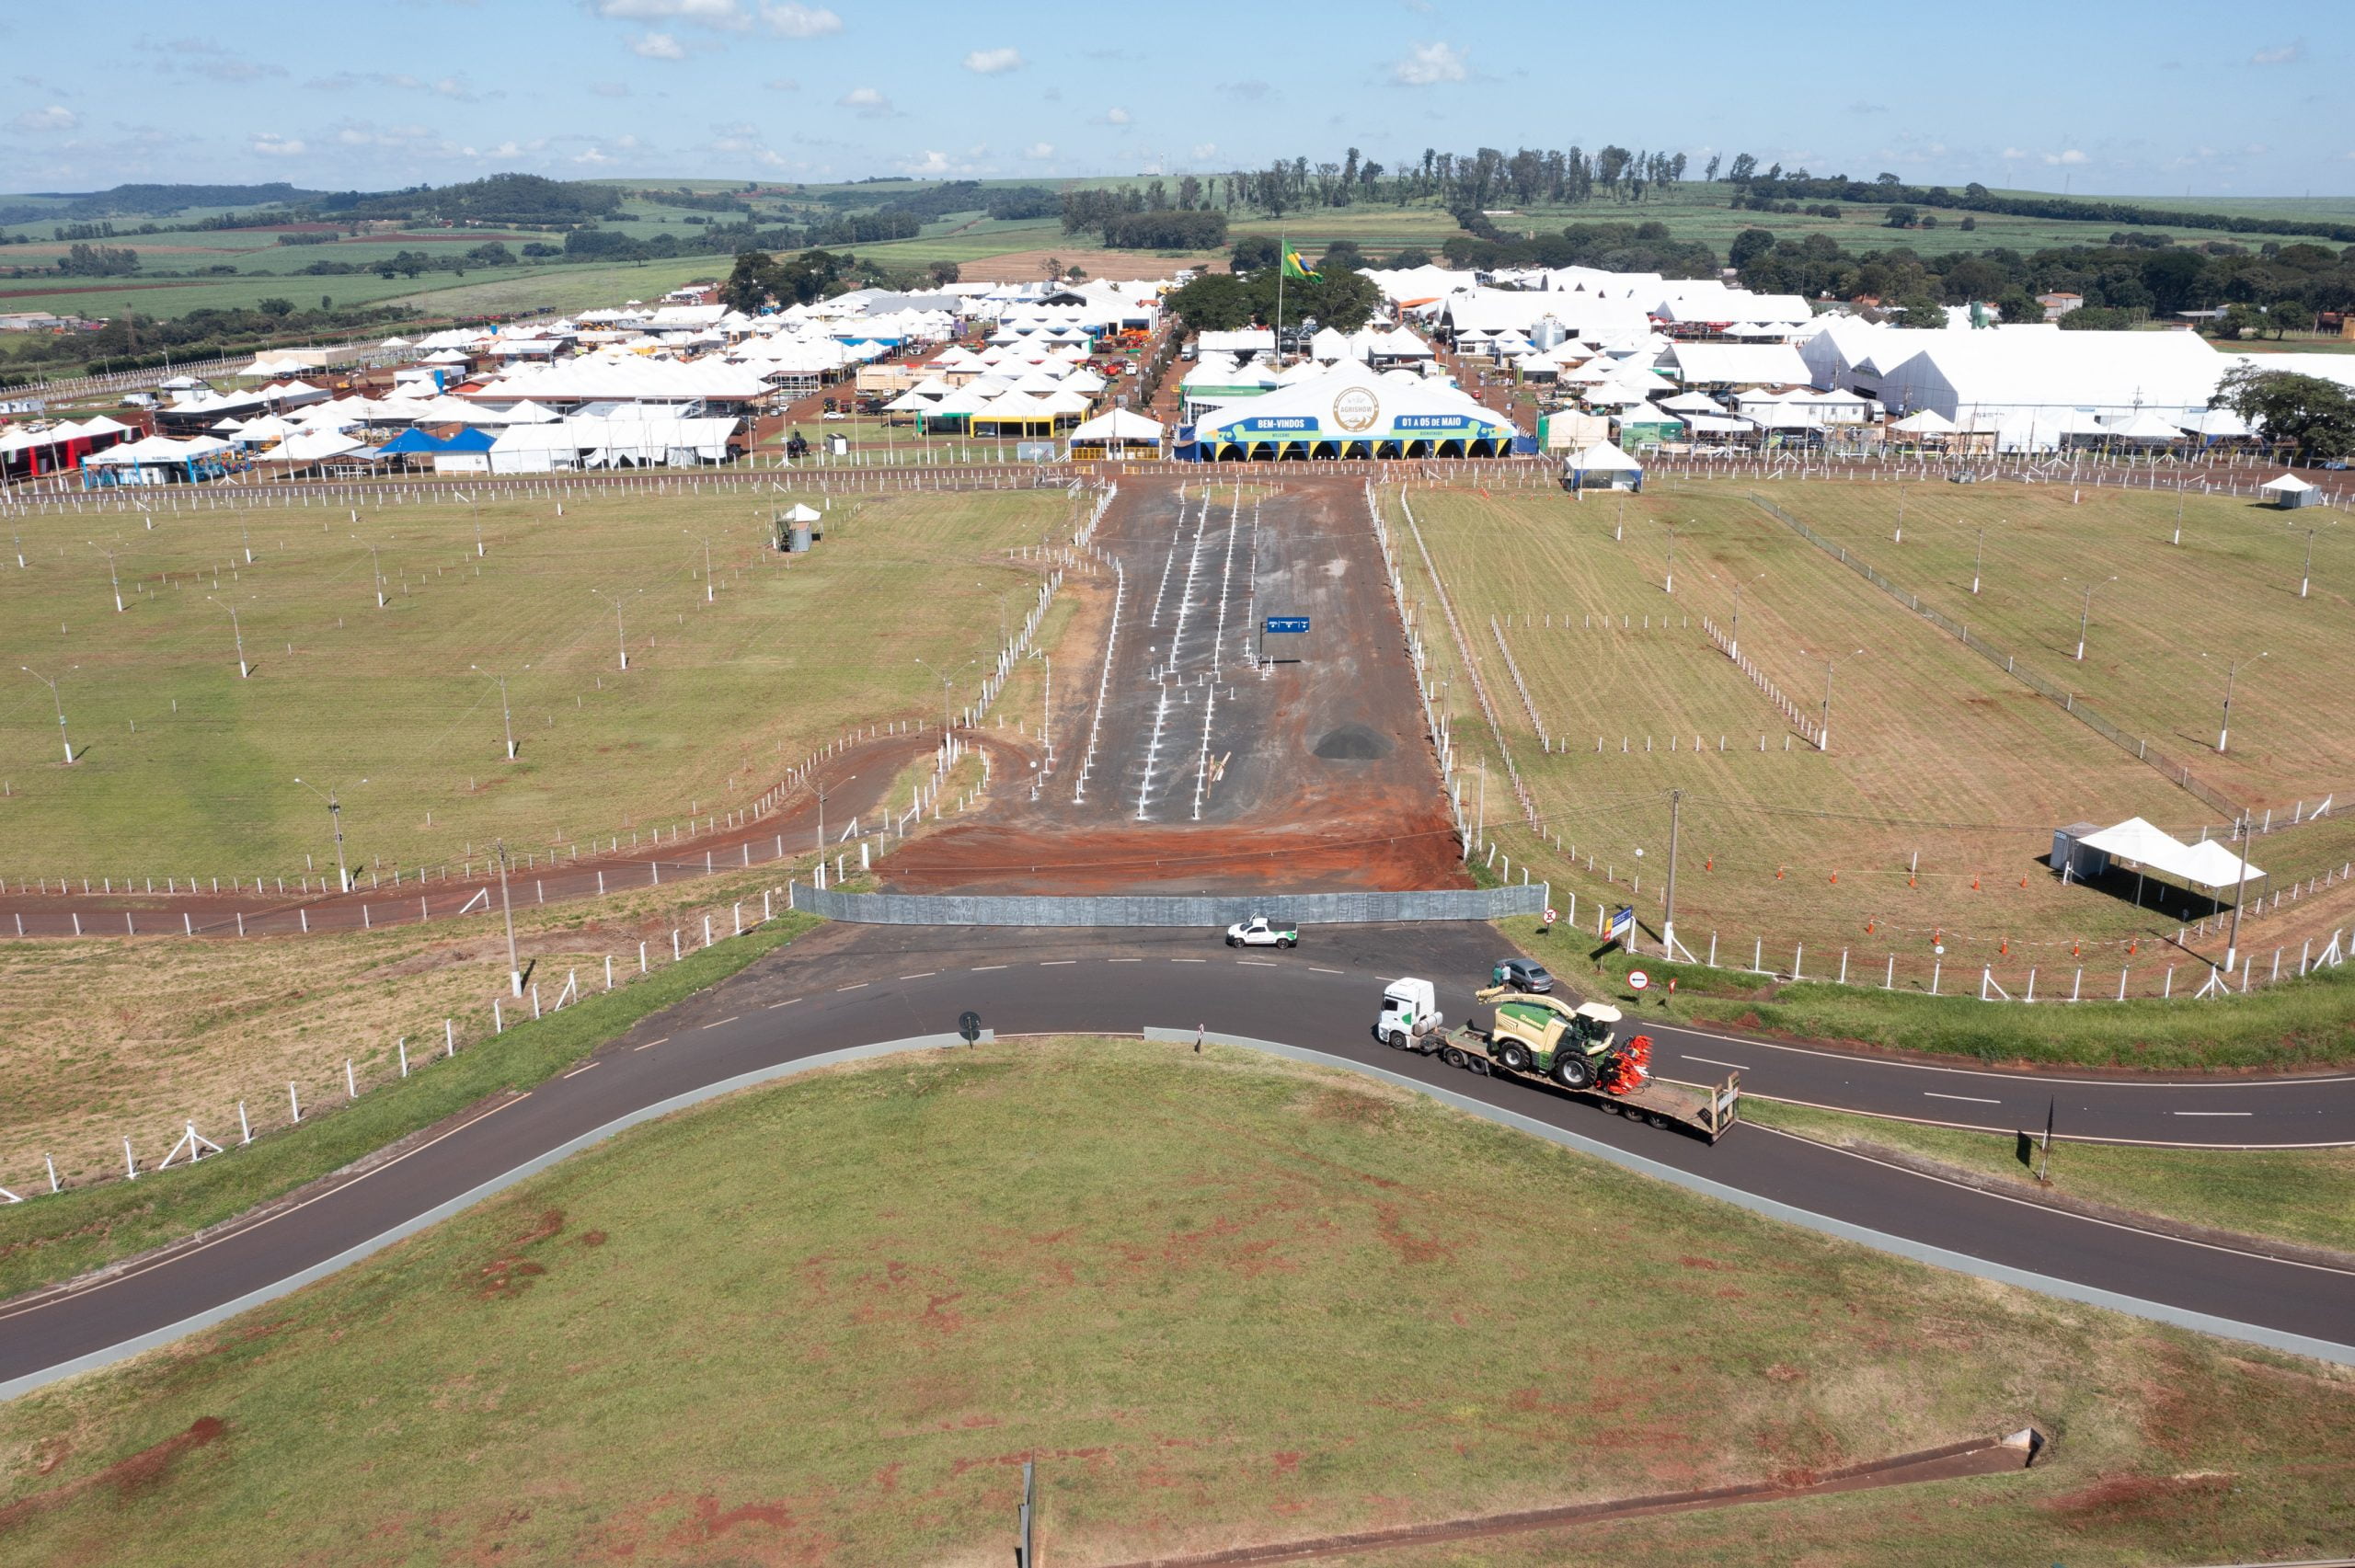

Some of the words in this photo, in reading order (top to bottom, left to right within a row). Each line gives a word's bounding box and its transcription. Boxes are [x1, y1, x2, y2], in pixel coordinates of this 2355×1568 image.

[1258, 419, 1304, 429] BEM-VINDOS
[1402, 418, 1411, 427] 01
[1420, 418, 1430, 427] 05
[1442, 417, 1461, 427] MAIO
